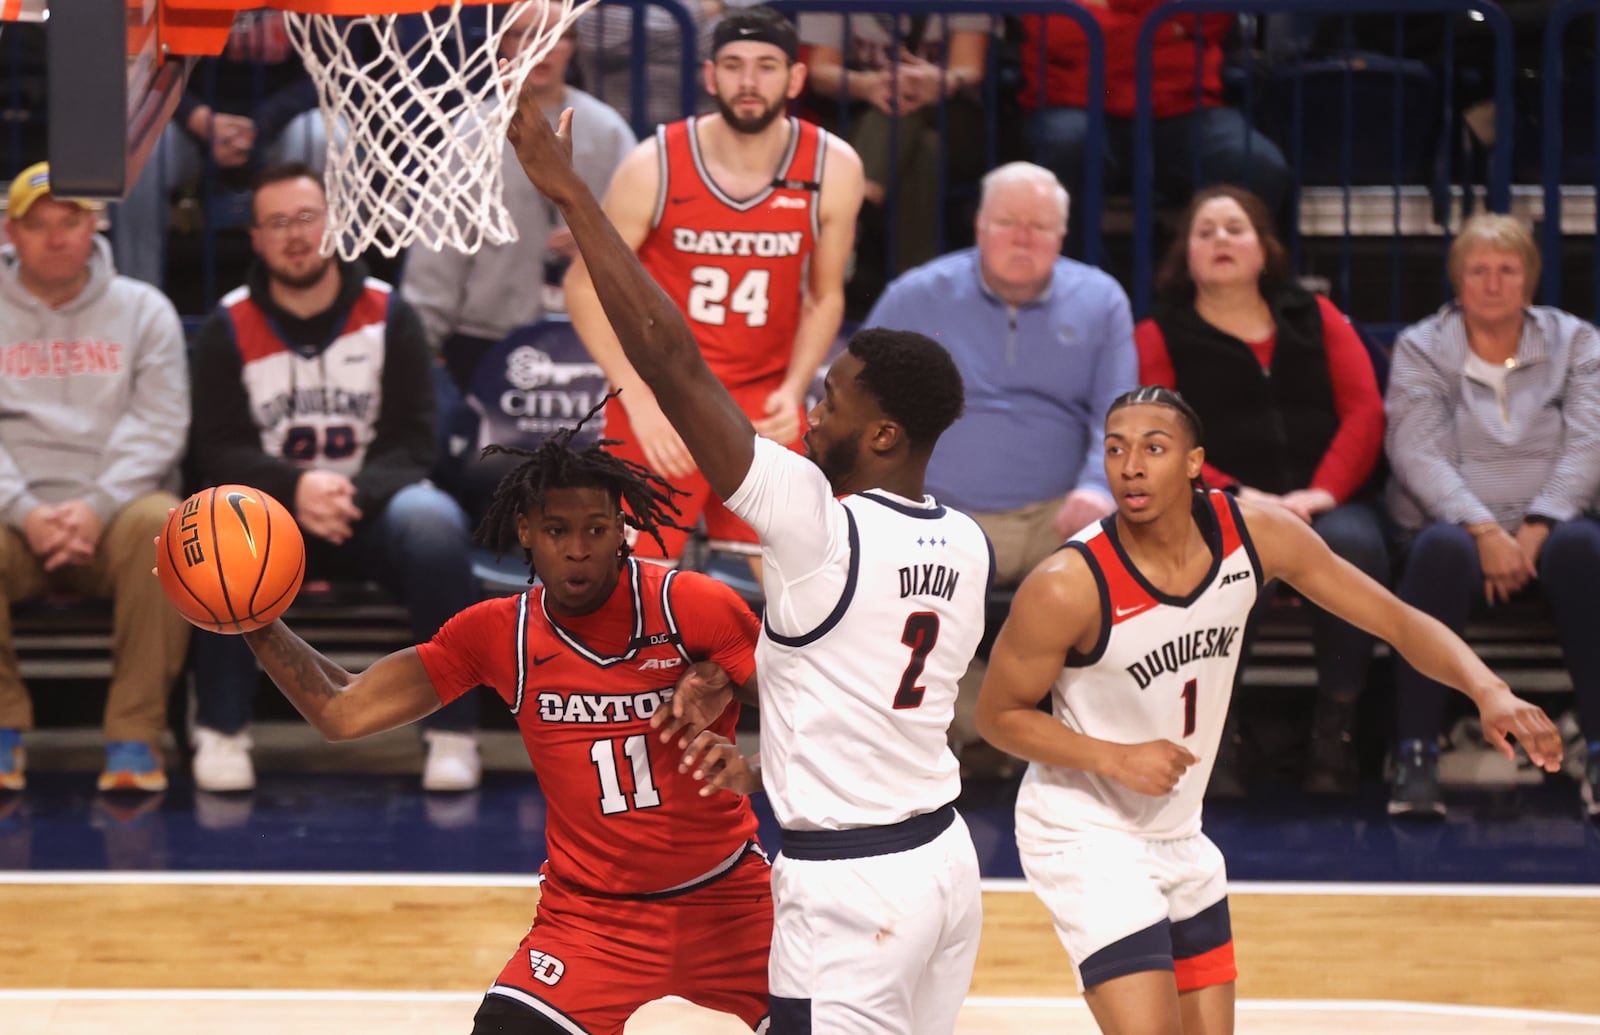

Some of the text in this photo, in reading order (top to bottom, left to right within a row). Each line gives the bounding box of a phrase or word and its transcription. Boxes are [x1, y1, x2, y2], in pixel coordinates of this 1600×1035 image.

[673, 228, 803, 258] DAYTON
[688, 265, 770, 327] 24
[181, 498, 205, 568] ELITE
[898, 563, 960, 602] DIXON
[1218, 570, 1251, 589] A10
[638, 657, 682, 671] A10
[892, 611, 940, 710] 2
[1125, 626, 1240, 691] DUQUESNE
[1180, 677, 1198, 739] 1
[590, 734, 661, 815] 11
